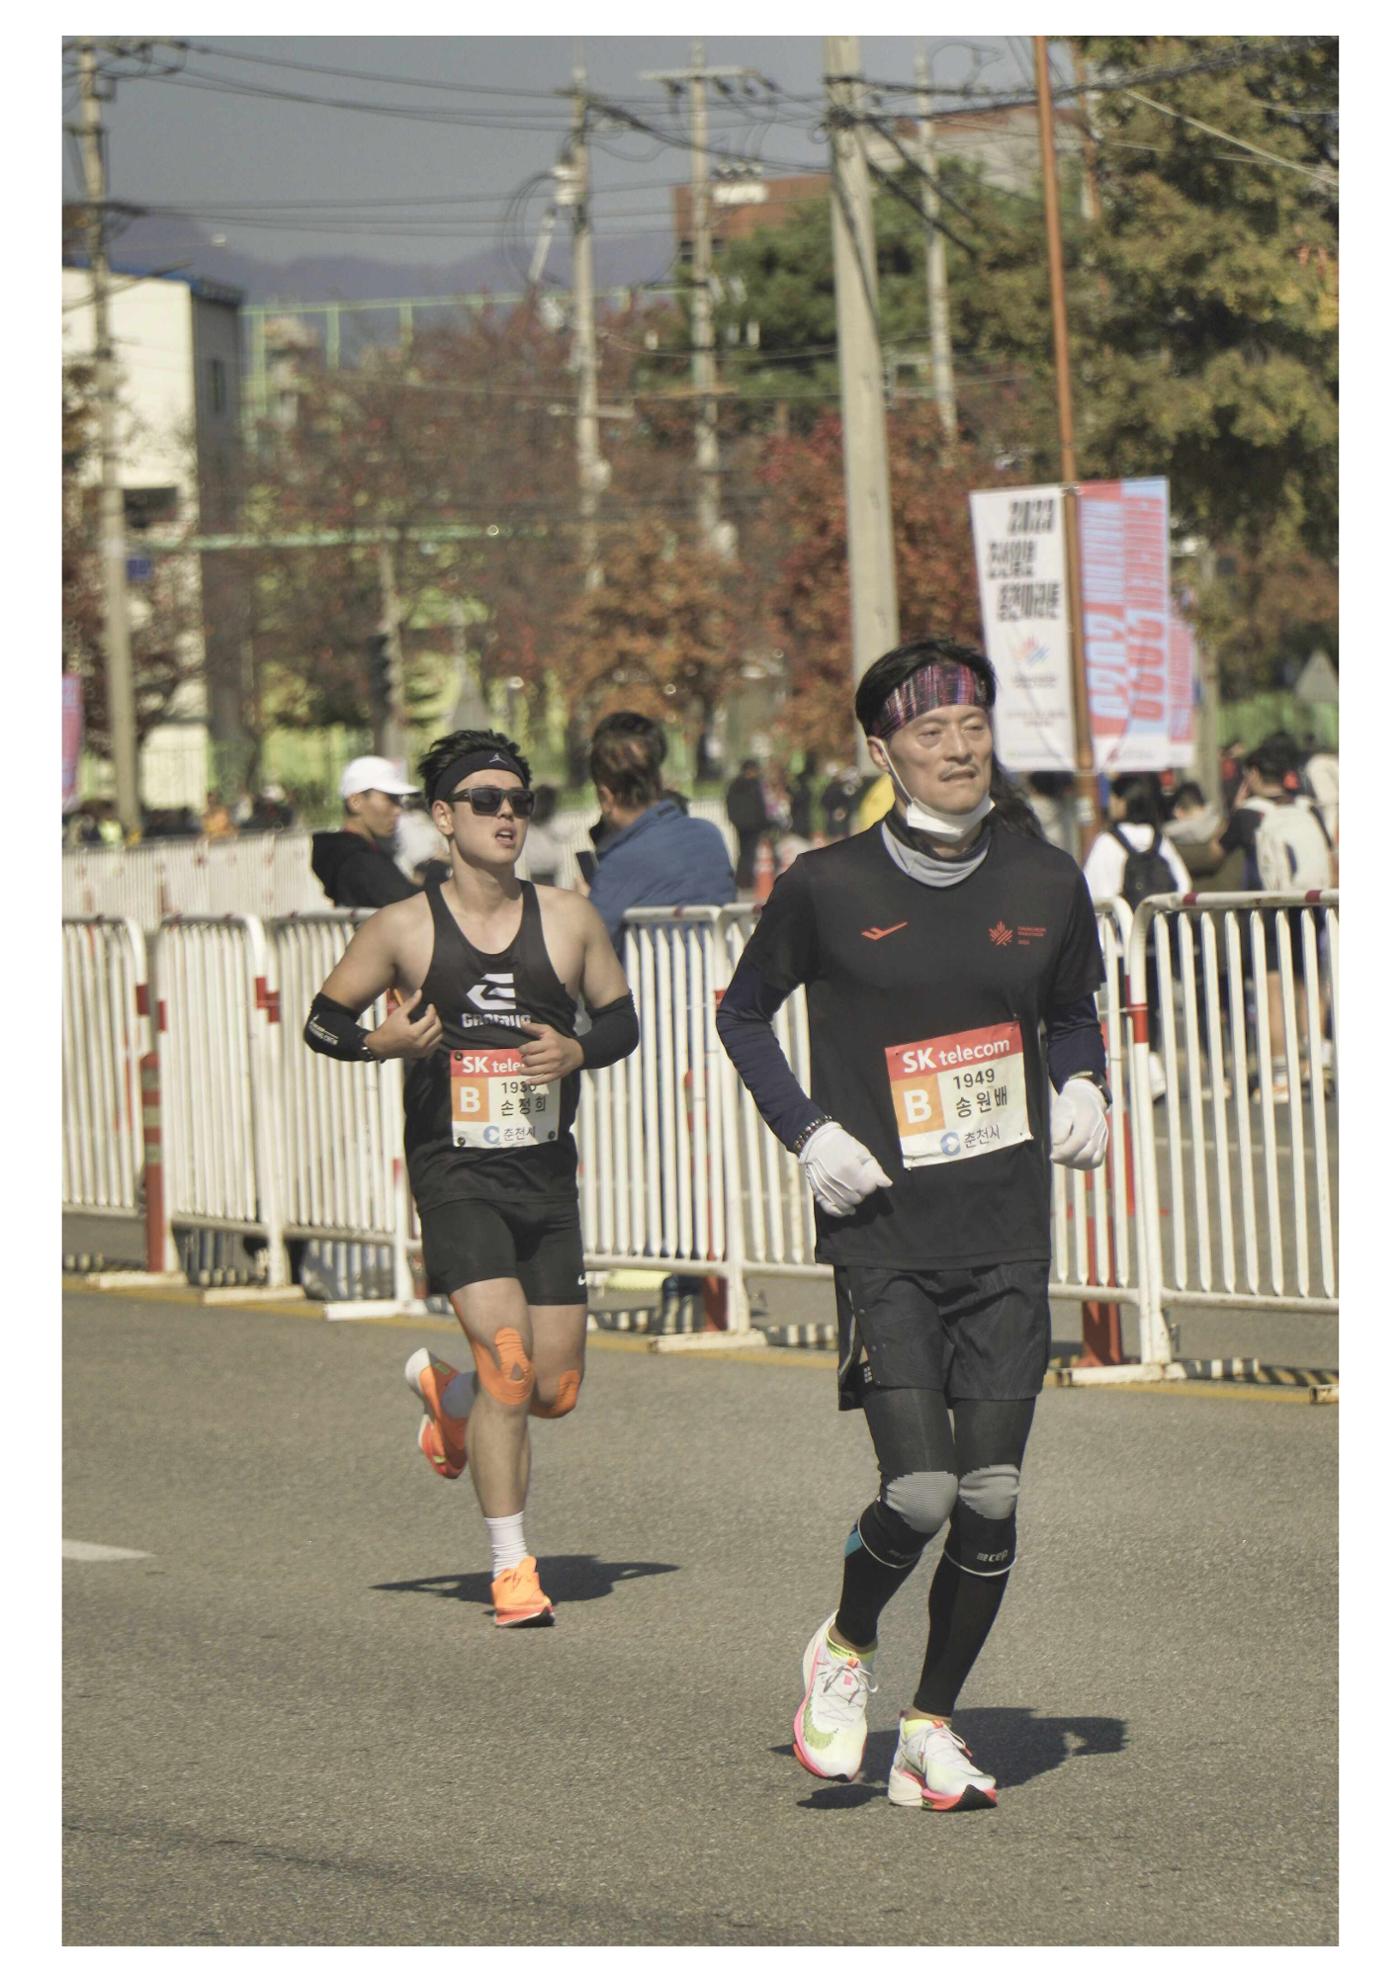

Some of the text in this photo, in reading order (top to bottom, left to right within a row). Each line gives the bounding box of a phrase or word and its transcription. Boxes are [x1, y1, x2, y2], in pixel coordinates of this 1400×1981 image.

[462, 1055, 525, 1074] SK tele
[902, 1039, 1010, 1073] SK telecom
[953, 1068, 995, 1090] 1949
[459, 1086, 481, 1114] B
[903, 1089, 933, 1124] B
[503, 1125, 536, 1142] 춘천시
[964, 1124, 1001, 1149] 춘천시
